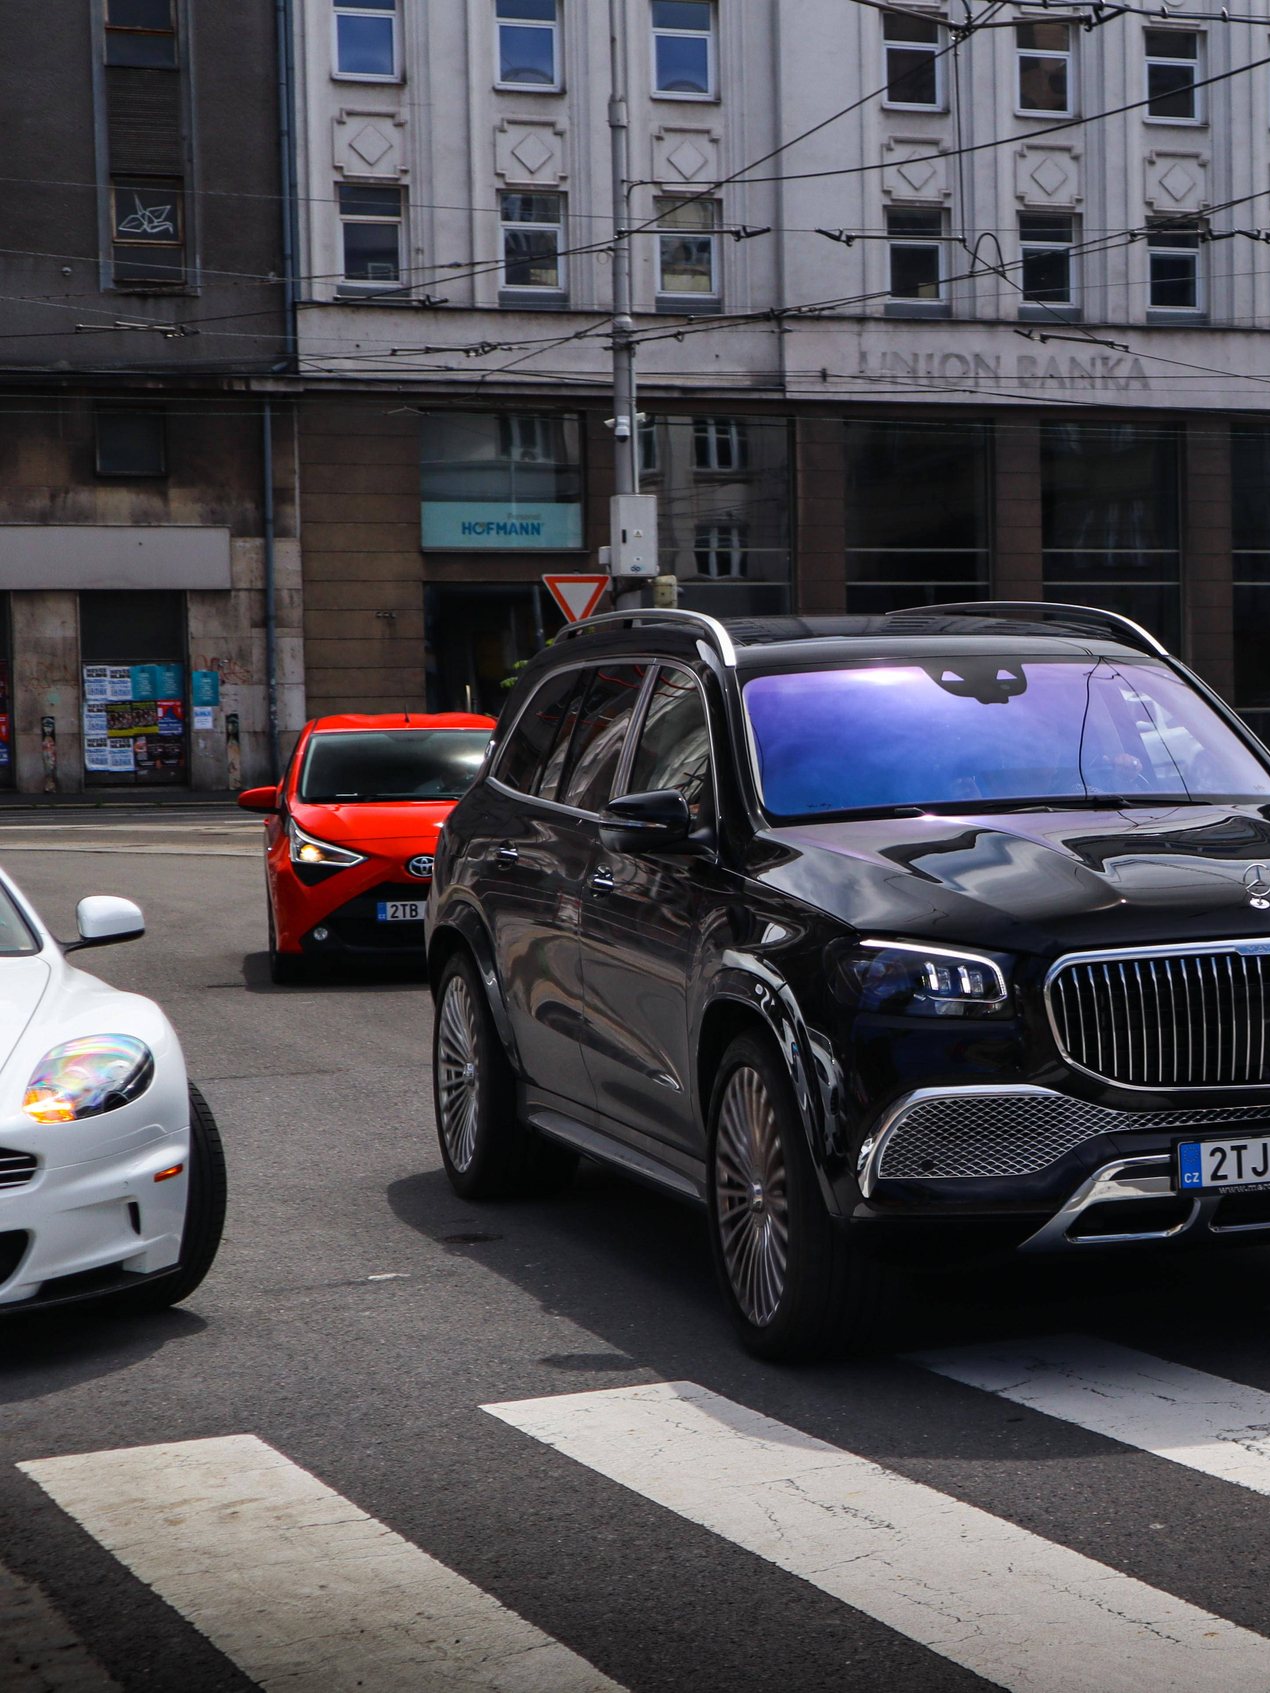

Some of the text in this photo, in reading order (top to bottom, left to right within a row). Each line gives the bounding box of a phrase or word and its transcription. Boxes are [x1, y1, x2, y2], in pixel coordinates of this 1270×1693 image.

[858, 351, 1151, 391] UNION BANKA
[461, 522, 541, 536] HOFMANN
[390, 903, 418, 919] 2TB
[1209, 1142, 1269, 1182] 2TJ
[1184, 1172, 1200, 1184] CZ
